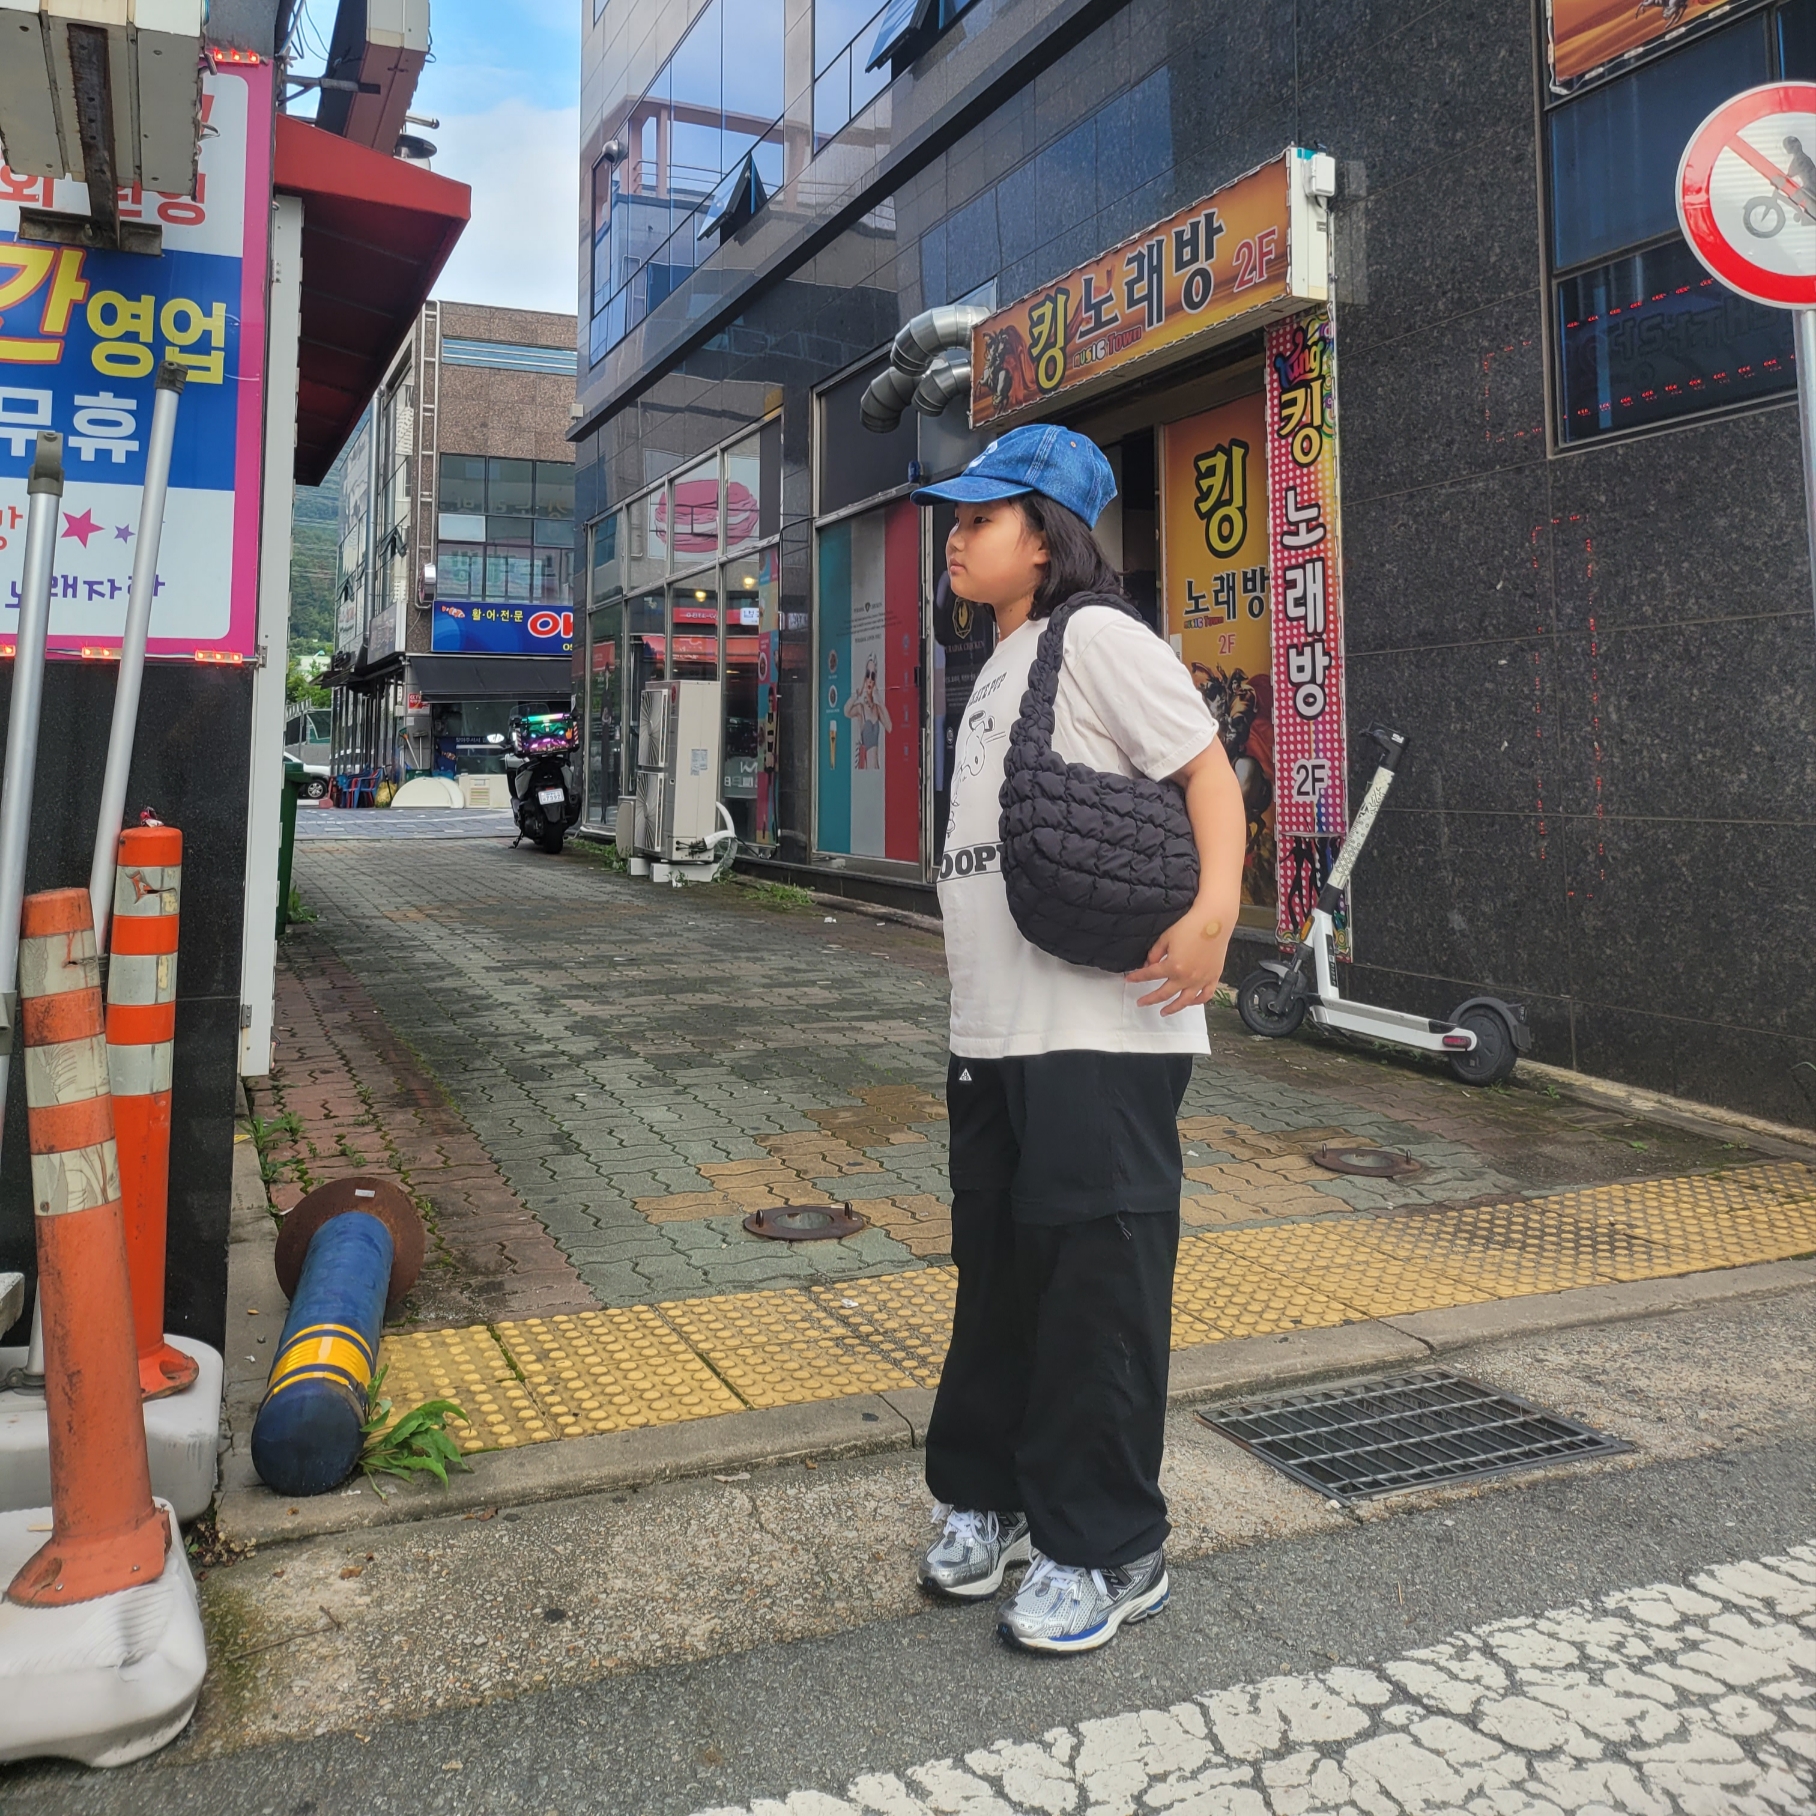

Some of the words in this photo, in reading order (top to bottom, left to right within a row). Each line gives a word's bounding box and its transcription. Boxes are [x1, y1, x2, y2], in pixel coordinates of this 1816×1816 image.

[86, 290, 227, 385] 영업
[1030, 288, 1069, 393] 킹
[1076, 209, 1225, 341] 노래방
[1232, 226, 1278, 293] 2F
[0, 386, 140, 464] 무휴
[1277, 378, 1326, 468] 킹
[1194, 438, 1249, 559] 킹
[1183, 567, 1270, 621] 노래방
[1280, 487, 1333, 722] 노래방
[1218, 634, 1236, 655] 2F
[1295, 763, 1328, 797] 2F
[940, 843, 1004, 881] OOP
